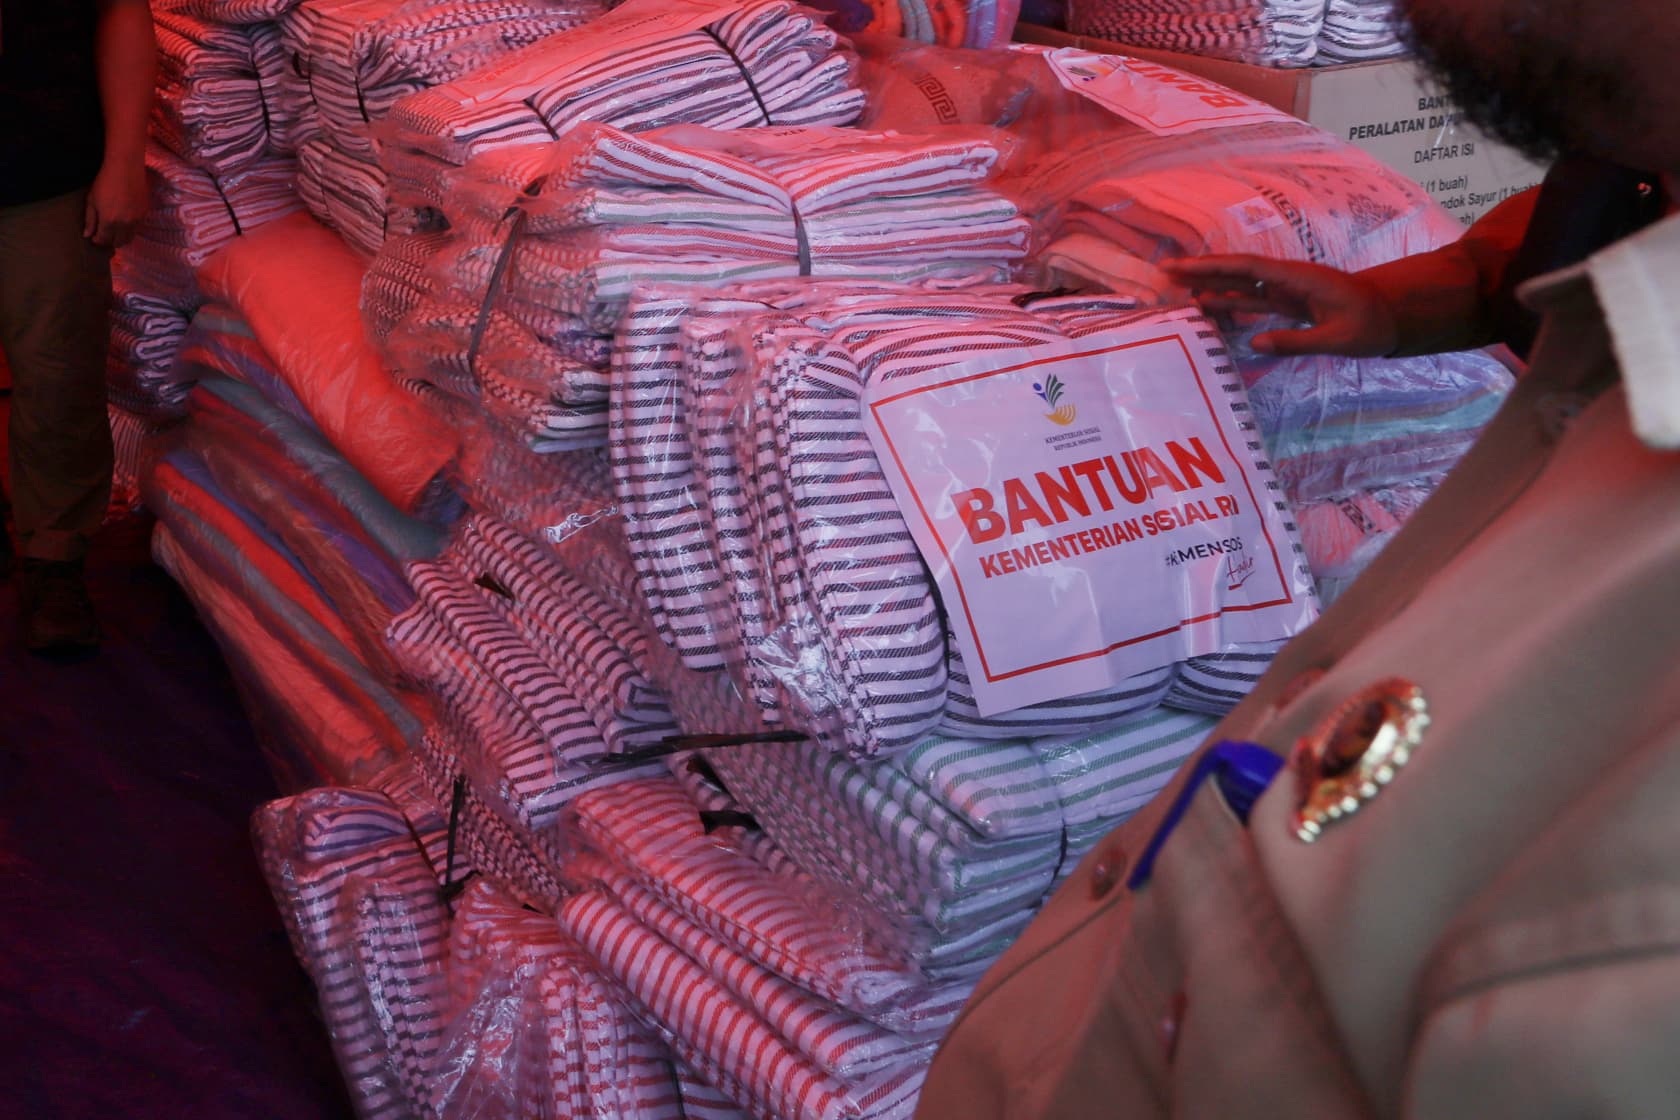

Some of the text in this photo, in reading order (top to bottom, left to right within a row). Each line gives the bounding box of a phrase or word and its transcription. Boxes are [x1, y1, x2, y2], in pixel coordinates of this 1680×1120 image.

[1349, 117, 1425, 141] PERALATAN
[1415, 143, 1475, 164] DAFTAR ISI
[1426, 180, 1436, 193] (1
[1439, 176, 1468, 192] buah)
[1468, 191, 1497, 207] Sayur
[950, 436, 1226, 544] BANTUAN
[978, 518, 1145, 578] KEMENTERIAN
[1214, 494, 1239, 517] RI
